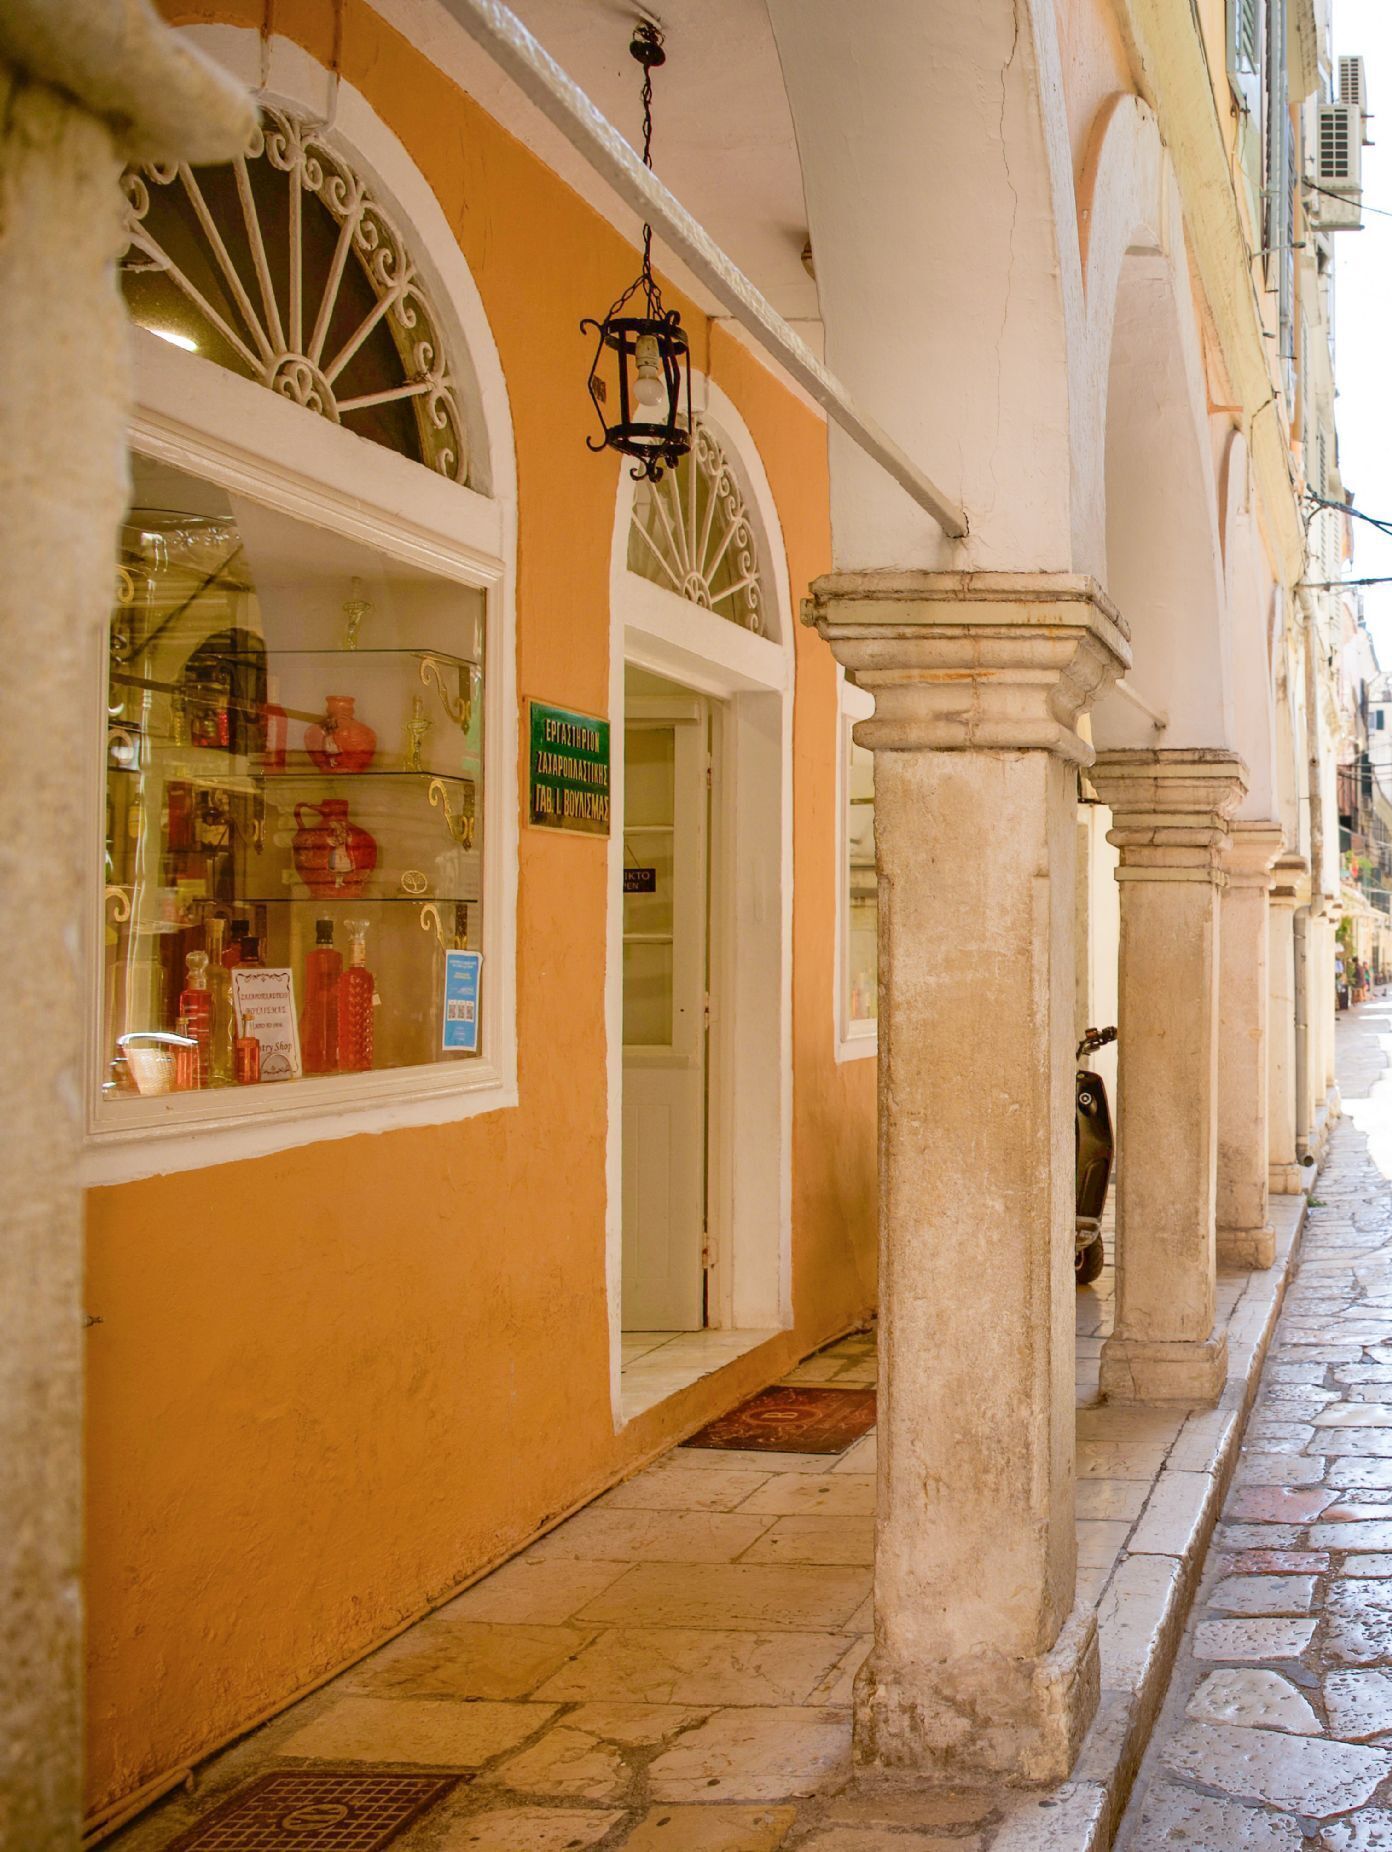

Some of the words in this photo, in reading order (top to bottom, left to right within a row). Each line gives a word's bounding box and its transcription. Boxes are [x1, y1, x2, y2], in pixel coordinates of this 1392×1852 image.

[546, 718, 600, 752] ΕΡΓΑΣΤΗΡΙΟΝ
[537, 751, 608, 786] ΖΑΧΑΡΟΠΛΑΣΤΙΚΗΣ
[564, 788, 609, 821] ΒΟΥΛΙΣΜΑΣ
[624, 872, 650, 880] ΙΚΤΟ
